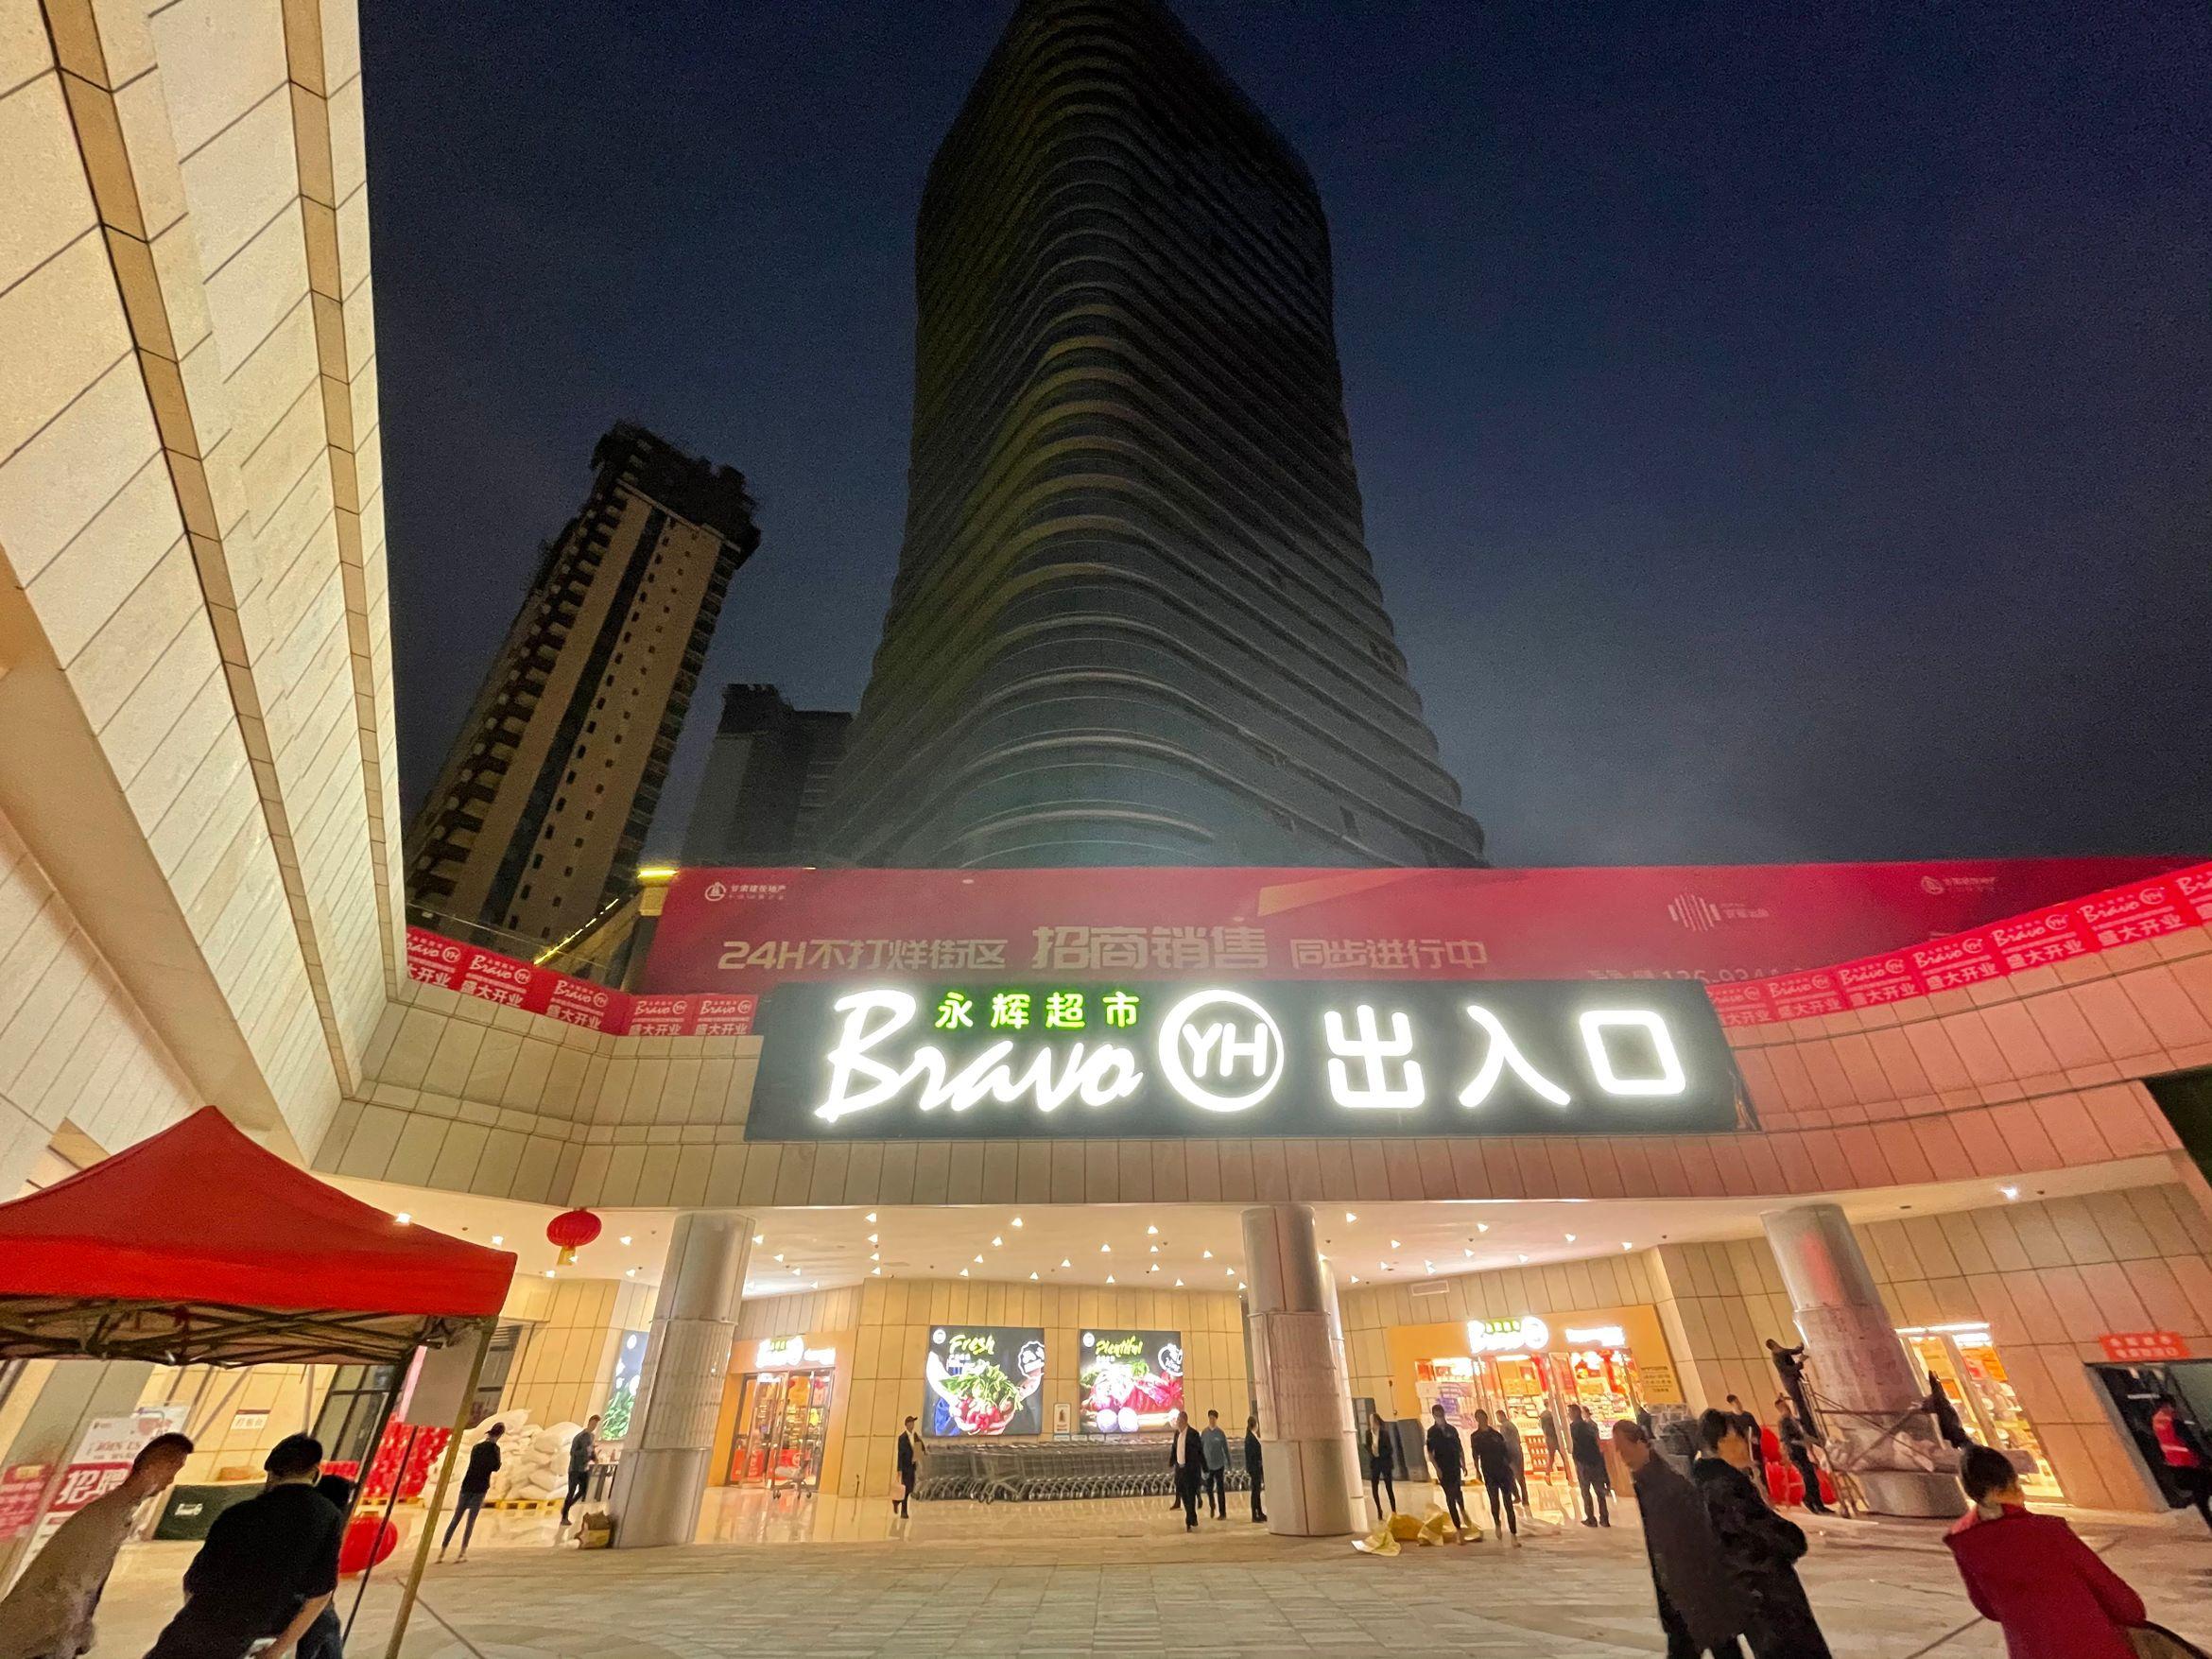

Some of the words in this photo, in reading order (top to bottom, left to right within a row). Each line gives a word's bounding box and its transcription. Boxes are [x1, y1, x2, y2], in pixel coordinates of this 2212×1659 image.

[717, 939, 1009, 970] 24H不打烊街区
[1031, 925, 1269, 970] 招商销售
[1290, 938, 1488, 970] 同步进行中
[1991, 926, 2046, 947] Bravo
[407, 942, 440, 957] ravo
[1912, 950, 1963, 968] Bravo
[469, 954, 511, 979] Bravo
[1839, 968, 1885, 985] Bravo
[460, 980, 524, 1008] 盛大开业
[554, 979, 591, 1003] Bravo
[1768, 982, 1812, 998] Bravo
[545, 1003, 602, 1030] 盛大开业
[634, 1000, 670, 1015] Bravo
[700, 1000, 735, 1014] Bravo
[935, 991, 1140, 1029] 永辉超市
[814, 989, 1145, 1123] Bravo
[1323, 1005, 1686, 1109] 出入口
[949, 1334, 995, 1355] Fresh
[1096, 1335, 1144, 1357] Plentiful
